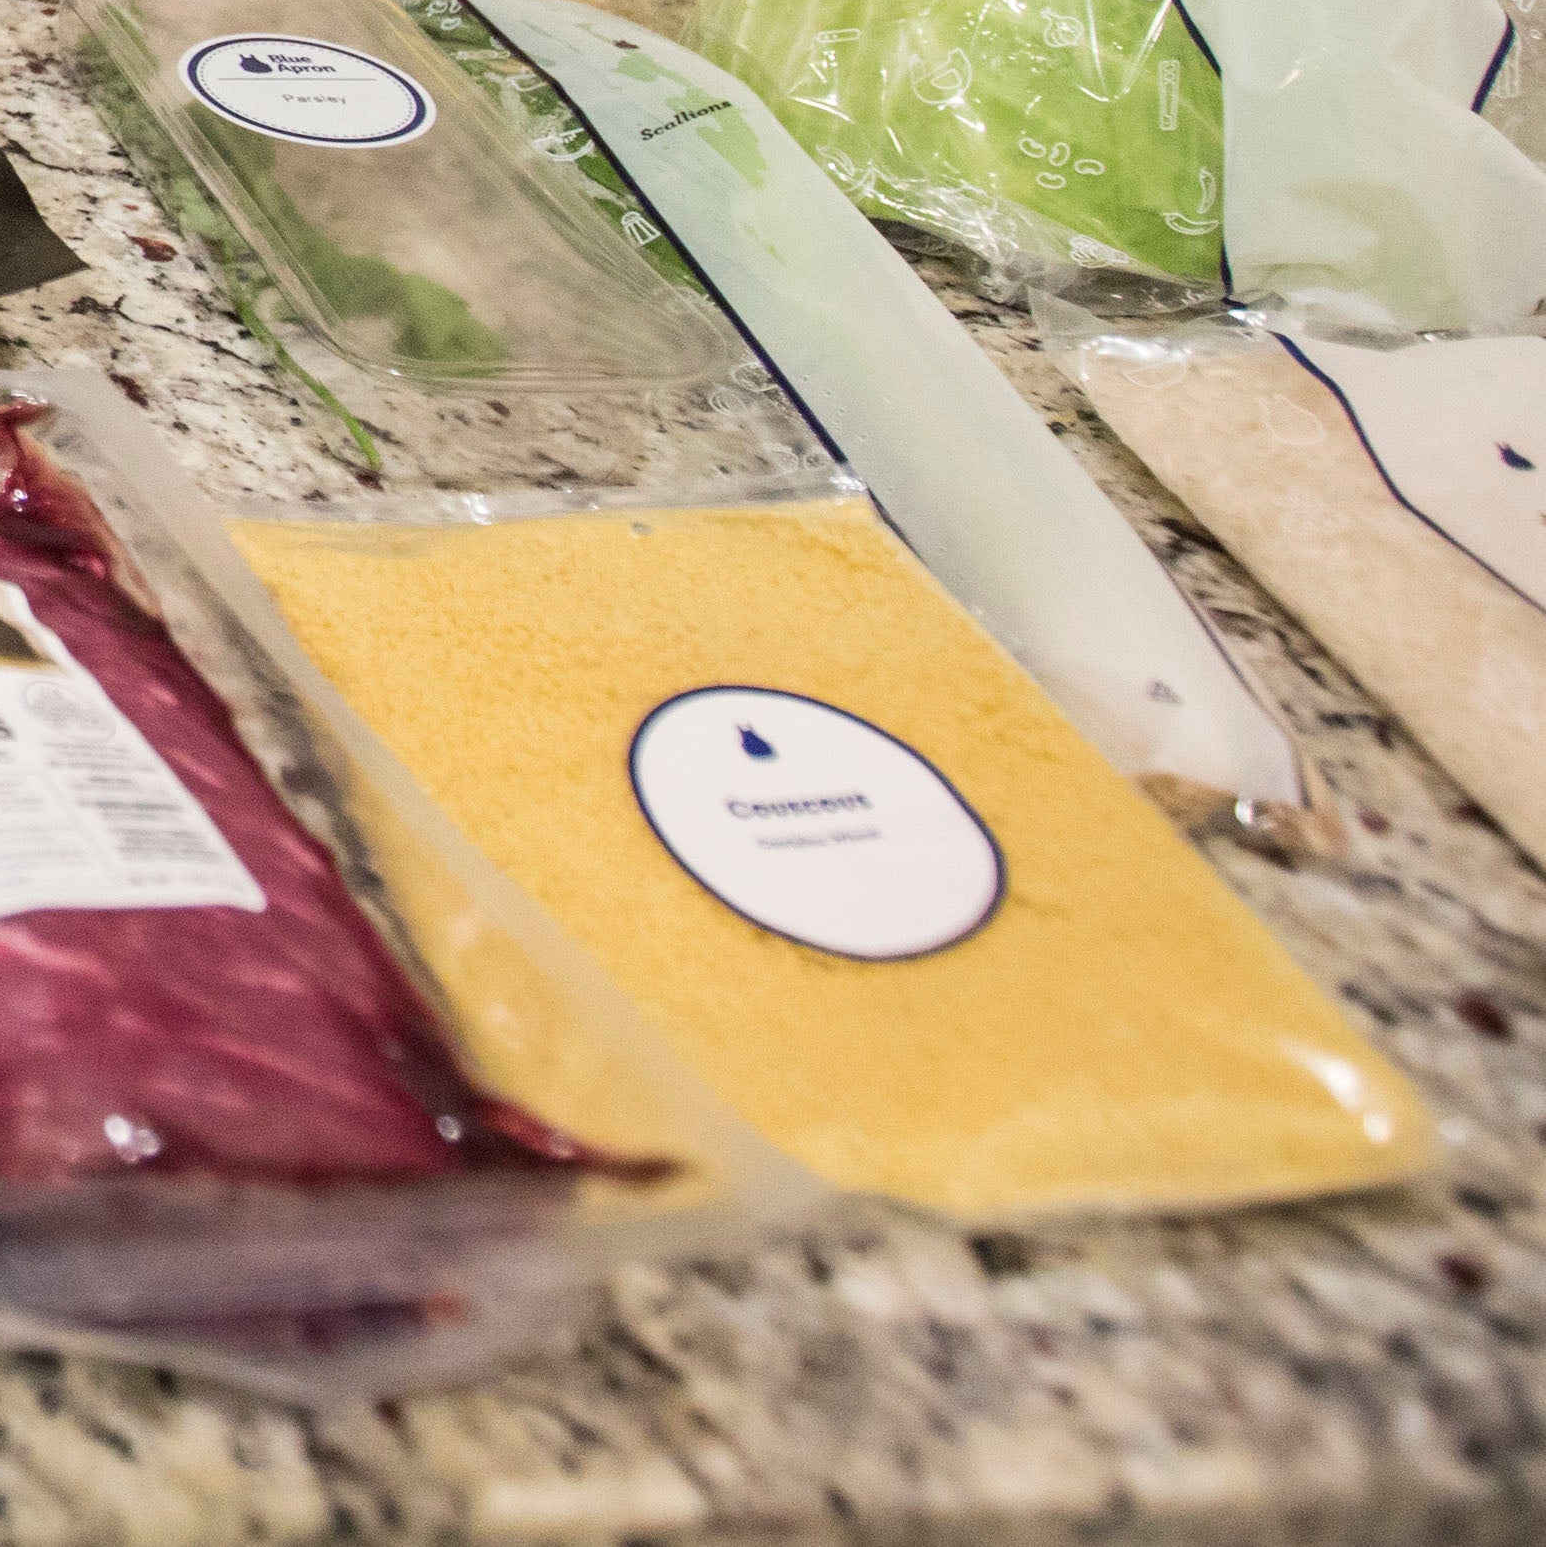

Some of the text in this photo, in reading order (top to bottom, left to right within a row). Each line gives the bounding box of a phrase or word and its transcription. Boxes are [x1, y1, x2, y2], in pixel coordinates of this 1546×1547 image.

[268, 53, 312, 64] Blue
[277, 63, 337, 75] Apron
[282, 93, 346, 105] Parsley
[639, 97, 733, 143] Scallions
[726, 794, 874, 820] Couscous
